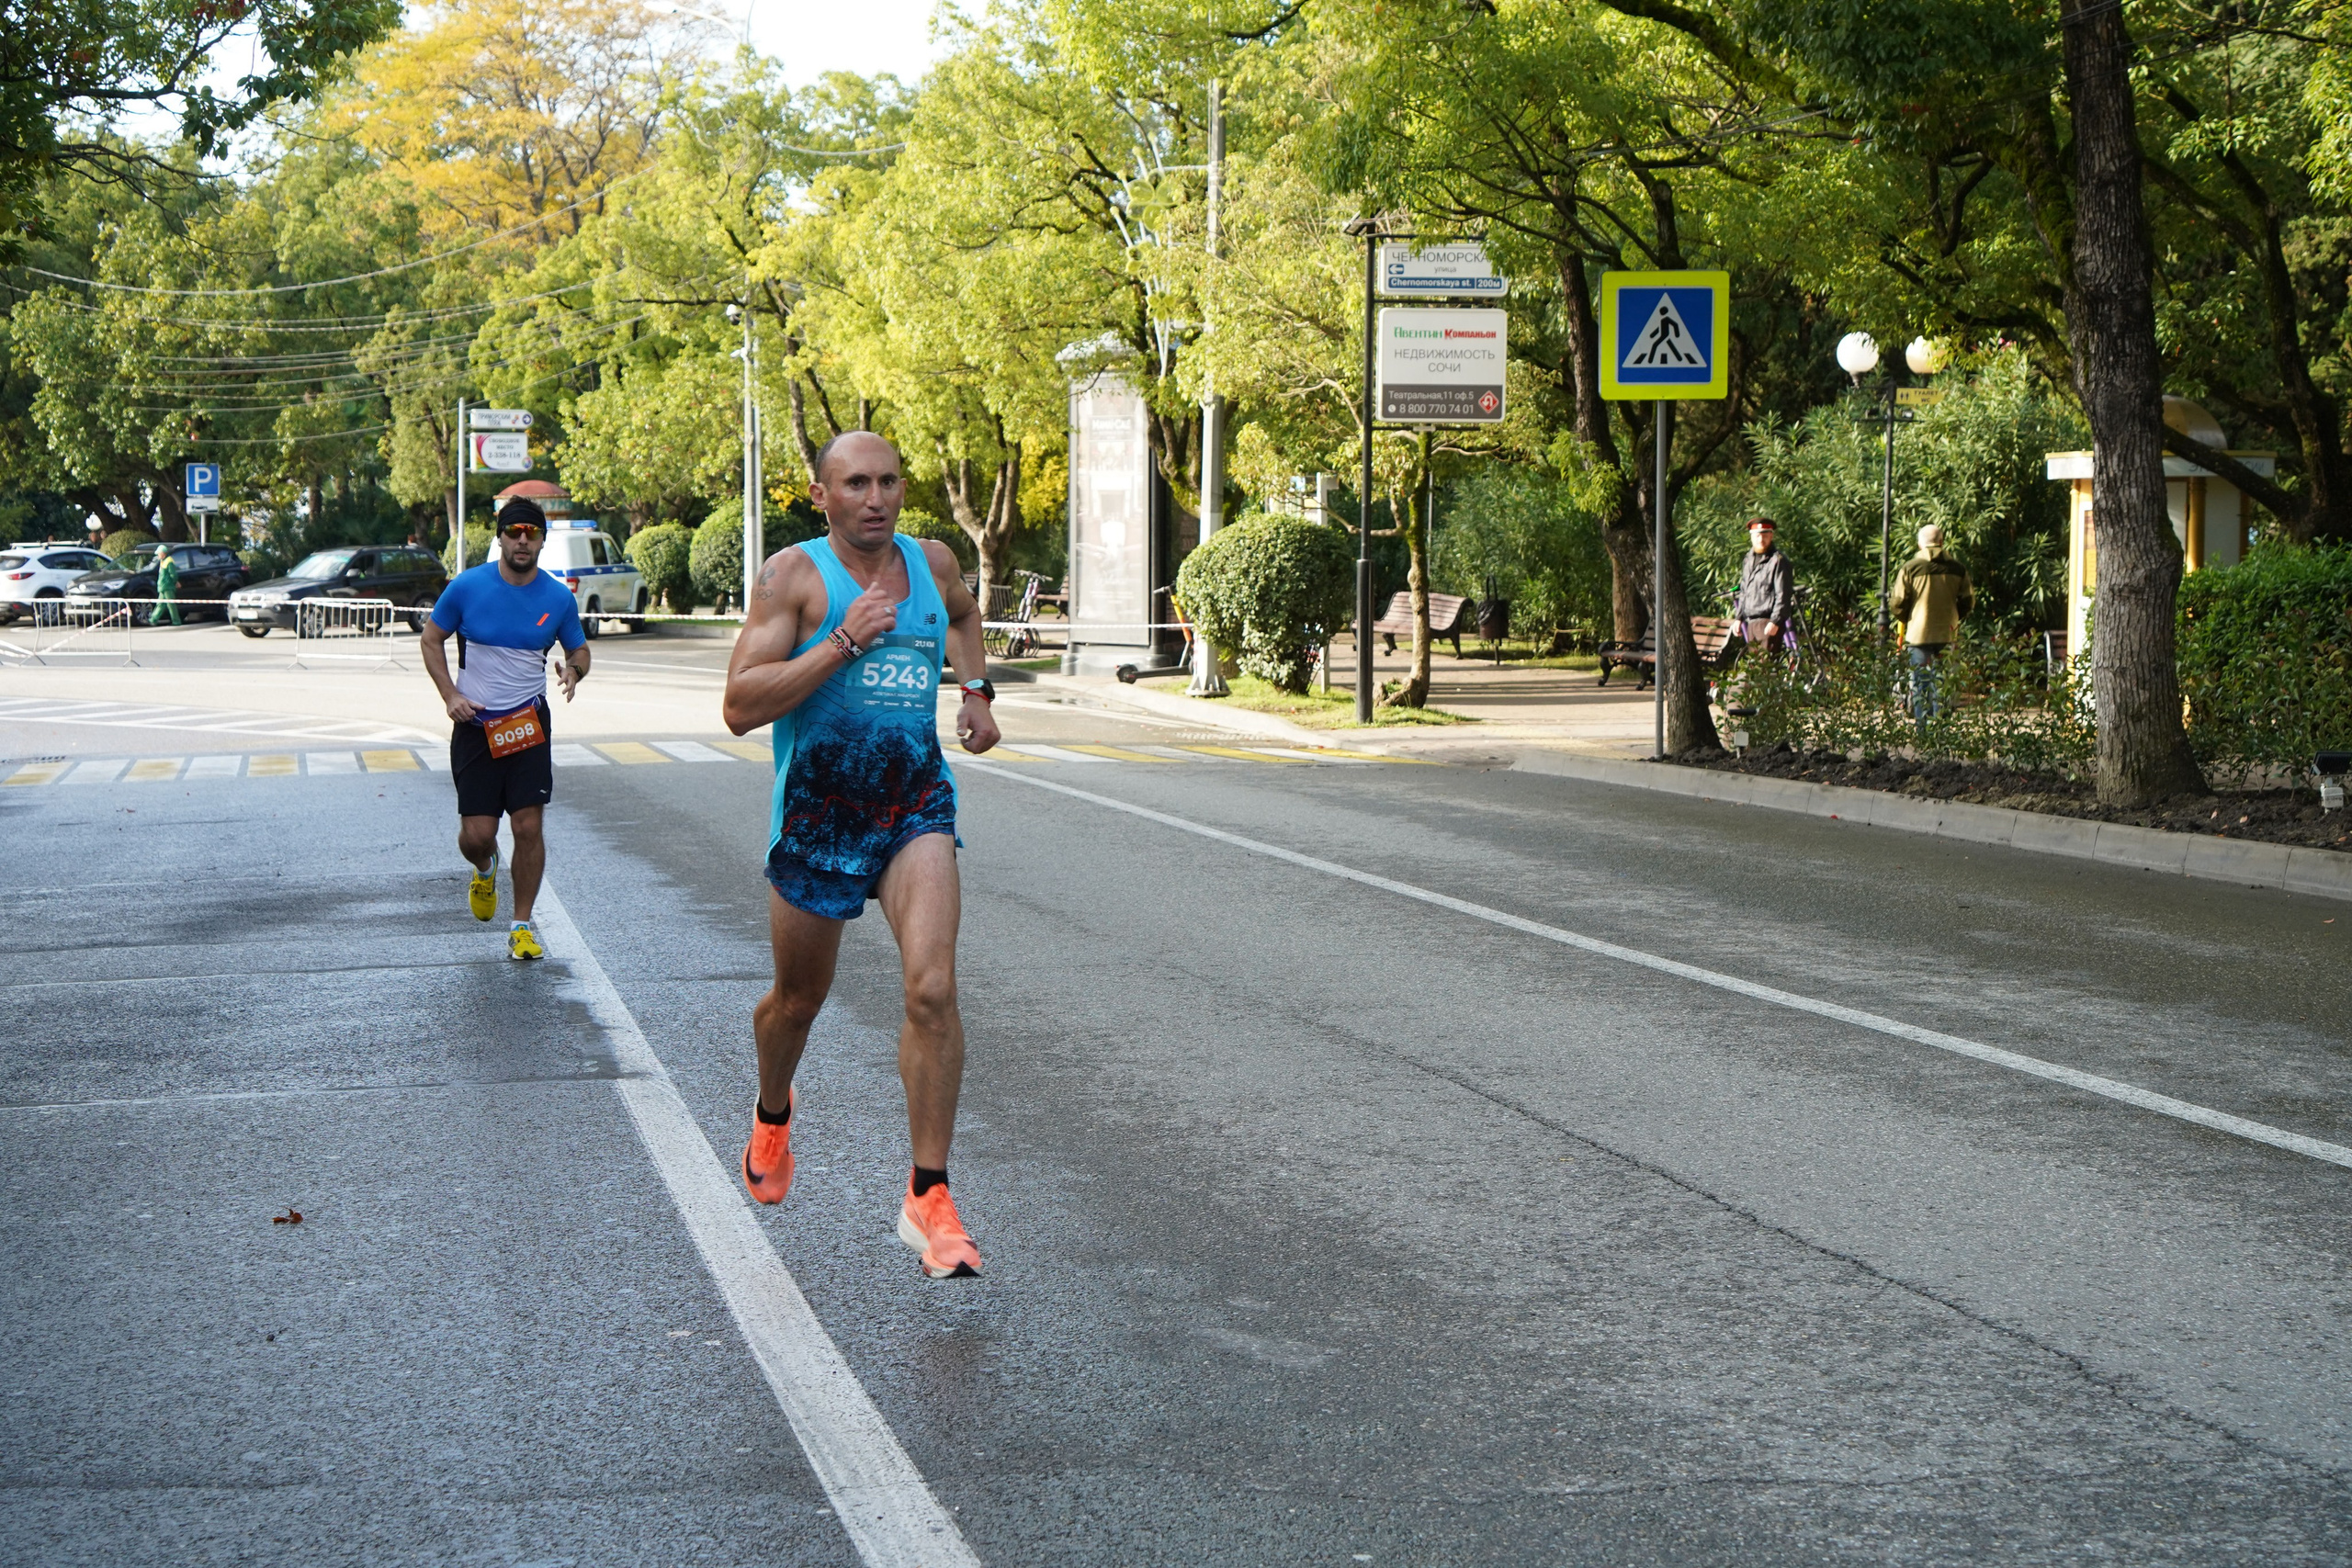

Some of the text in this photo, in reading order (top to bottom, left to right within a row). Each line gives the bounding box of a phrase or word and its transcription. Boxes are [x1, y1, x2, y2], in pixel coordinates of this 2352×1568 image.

[1392, 252, 1492, 263] ЧЕРНОМОРСКА
[1390, 277, 1472, 288] Chernomorskaya st.
[1394, 348, 1496, 360] НЕДВИЖИМОСТЬ
[1428, 362, 1461, 372] СОЧИ
[1454, 391, 1475, 401] оф.5
[1399, 404, 1474, 413] 8 800 770 74 01
[194, 467, 212, 492] P
[862, 662, 929, 690] 5243
[494, 723, 535, 746] 9098
